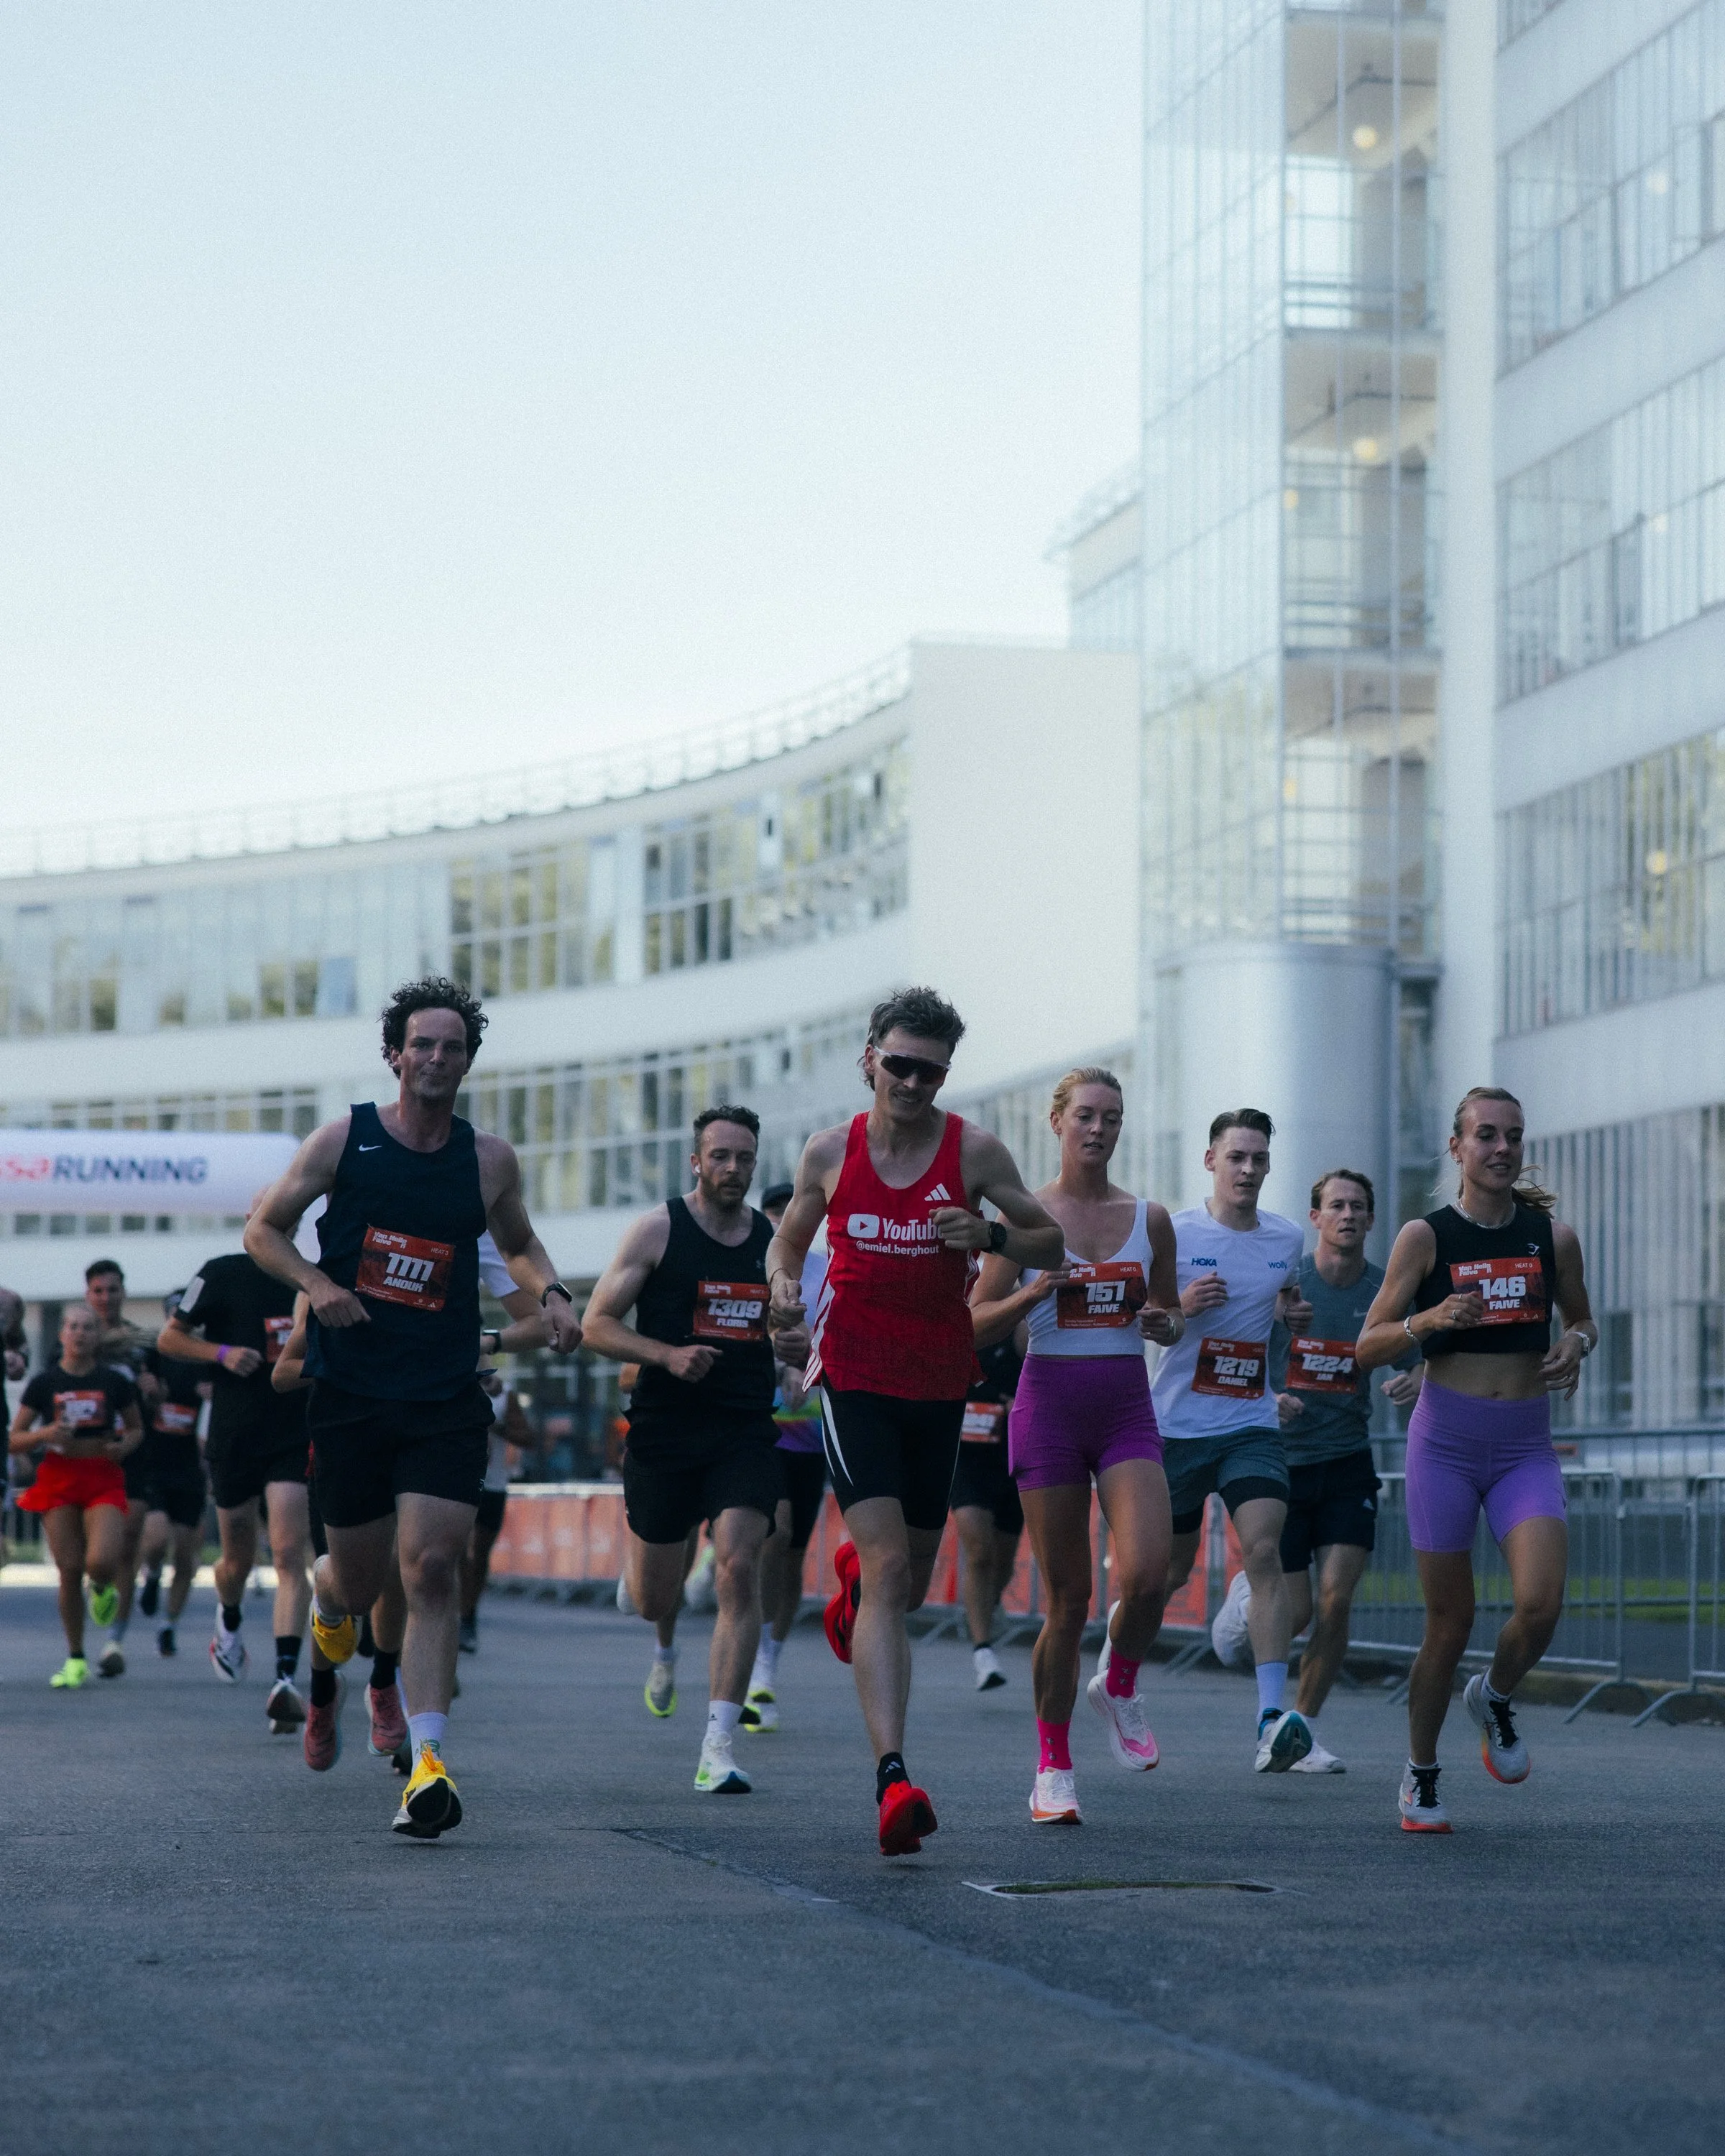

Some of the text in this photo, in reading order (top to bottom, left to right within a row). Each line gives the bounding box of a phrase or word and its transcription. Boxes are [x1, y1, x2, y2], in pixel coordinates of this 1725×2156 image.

[856, 1240, 939, 1257] @emiel.berghout
[386, 1252, 435, 1281] 1111
[1192, 1258, 1217, 1266] HOKA
[383, 1276, 424, 1293] ANOUK
[1085, 1281, 1126, 1303] 151
[1478, 1276, 1526, 1299] 146
[708, 1299, 763, 1319] 1309
[1087, 1304, 1120, 1314] FAIVE
[1489, 1299, 1520, 1310] FAIVE
[716, 1318, 749, 1328] FLORIS
[1213, 1355, 1260, 1377] 1219
[1302, 1353, 1353, 1373] 1224
[1218, 1376, 1248, 1386] DANIEL
